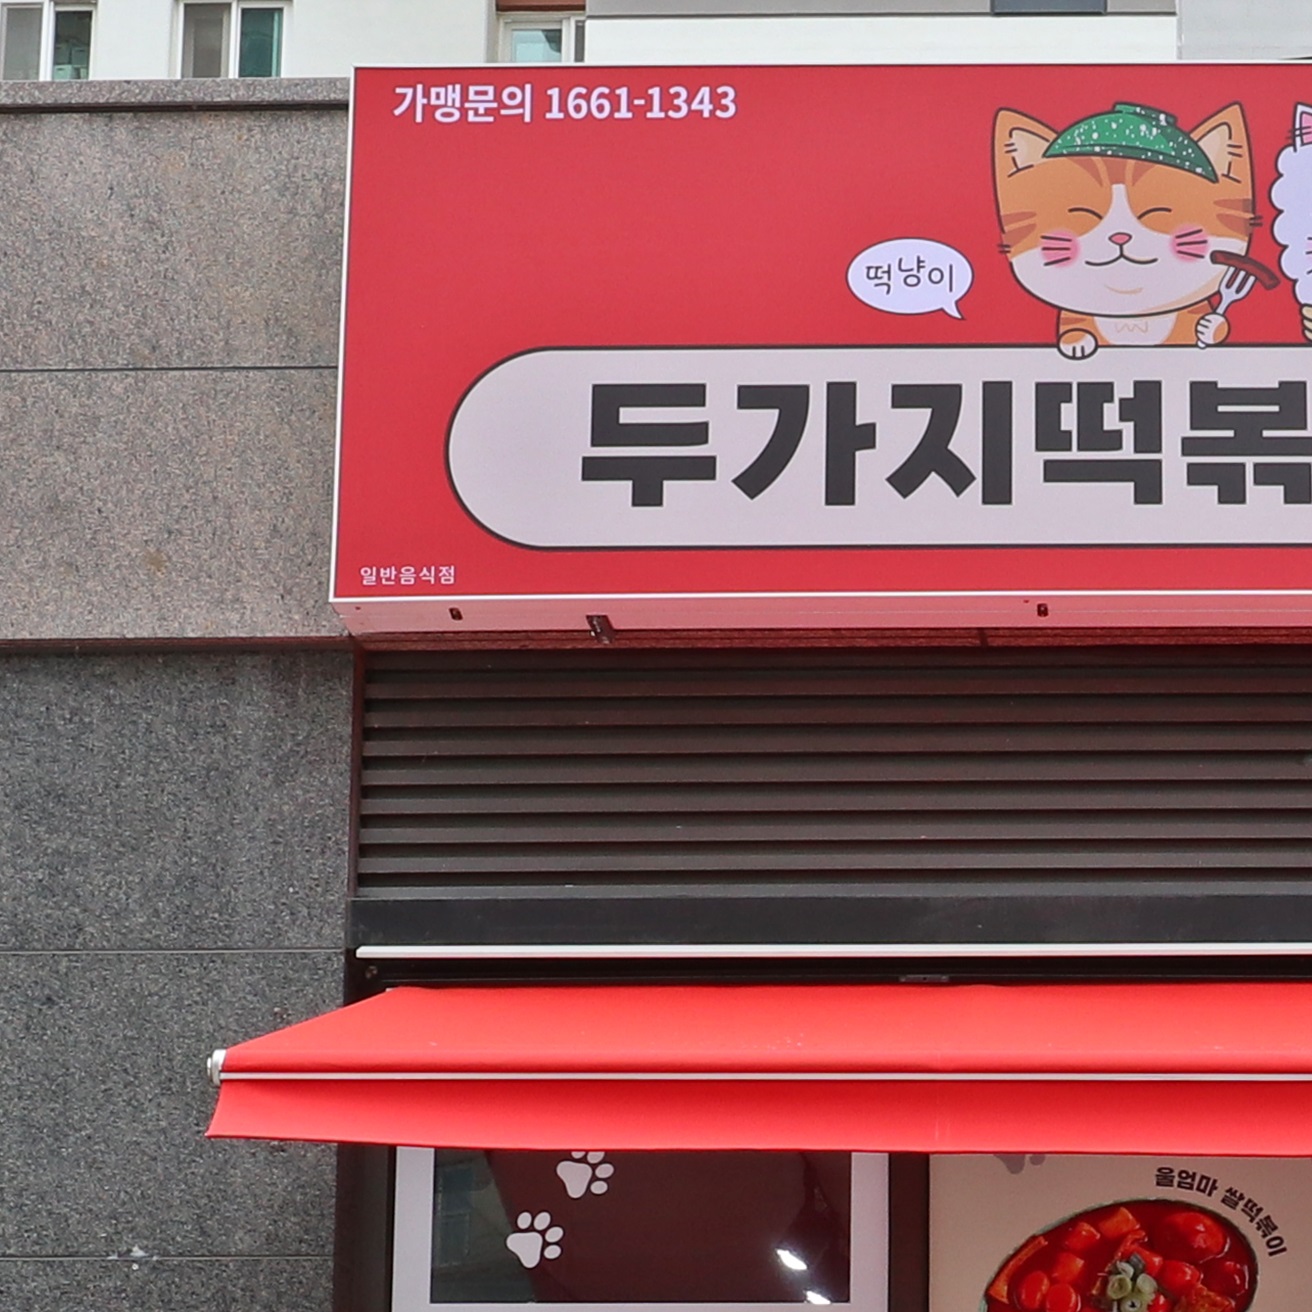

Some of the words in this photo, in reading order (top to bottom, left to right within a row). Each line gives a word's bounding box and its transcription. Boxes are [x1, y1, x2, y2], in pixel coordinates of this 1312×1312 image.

[393, 84, 533, 124] 가맹문의
[544, 86, 738, 119] 1661-1343
[864, 255, 956, 296] 떡냥이
[360, 566, 457, 586] 일반음식점
[1221, 1186, 1287, 1257] 쌀떡볶이
